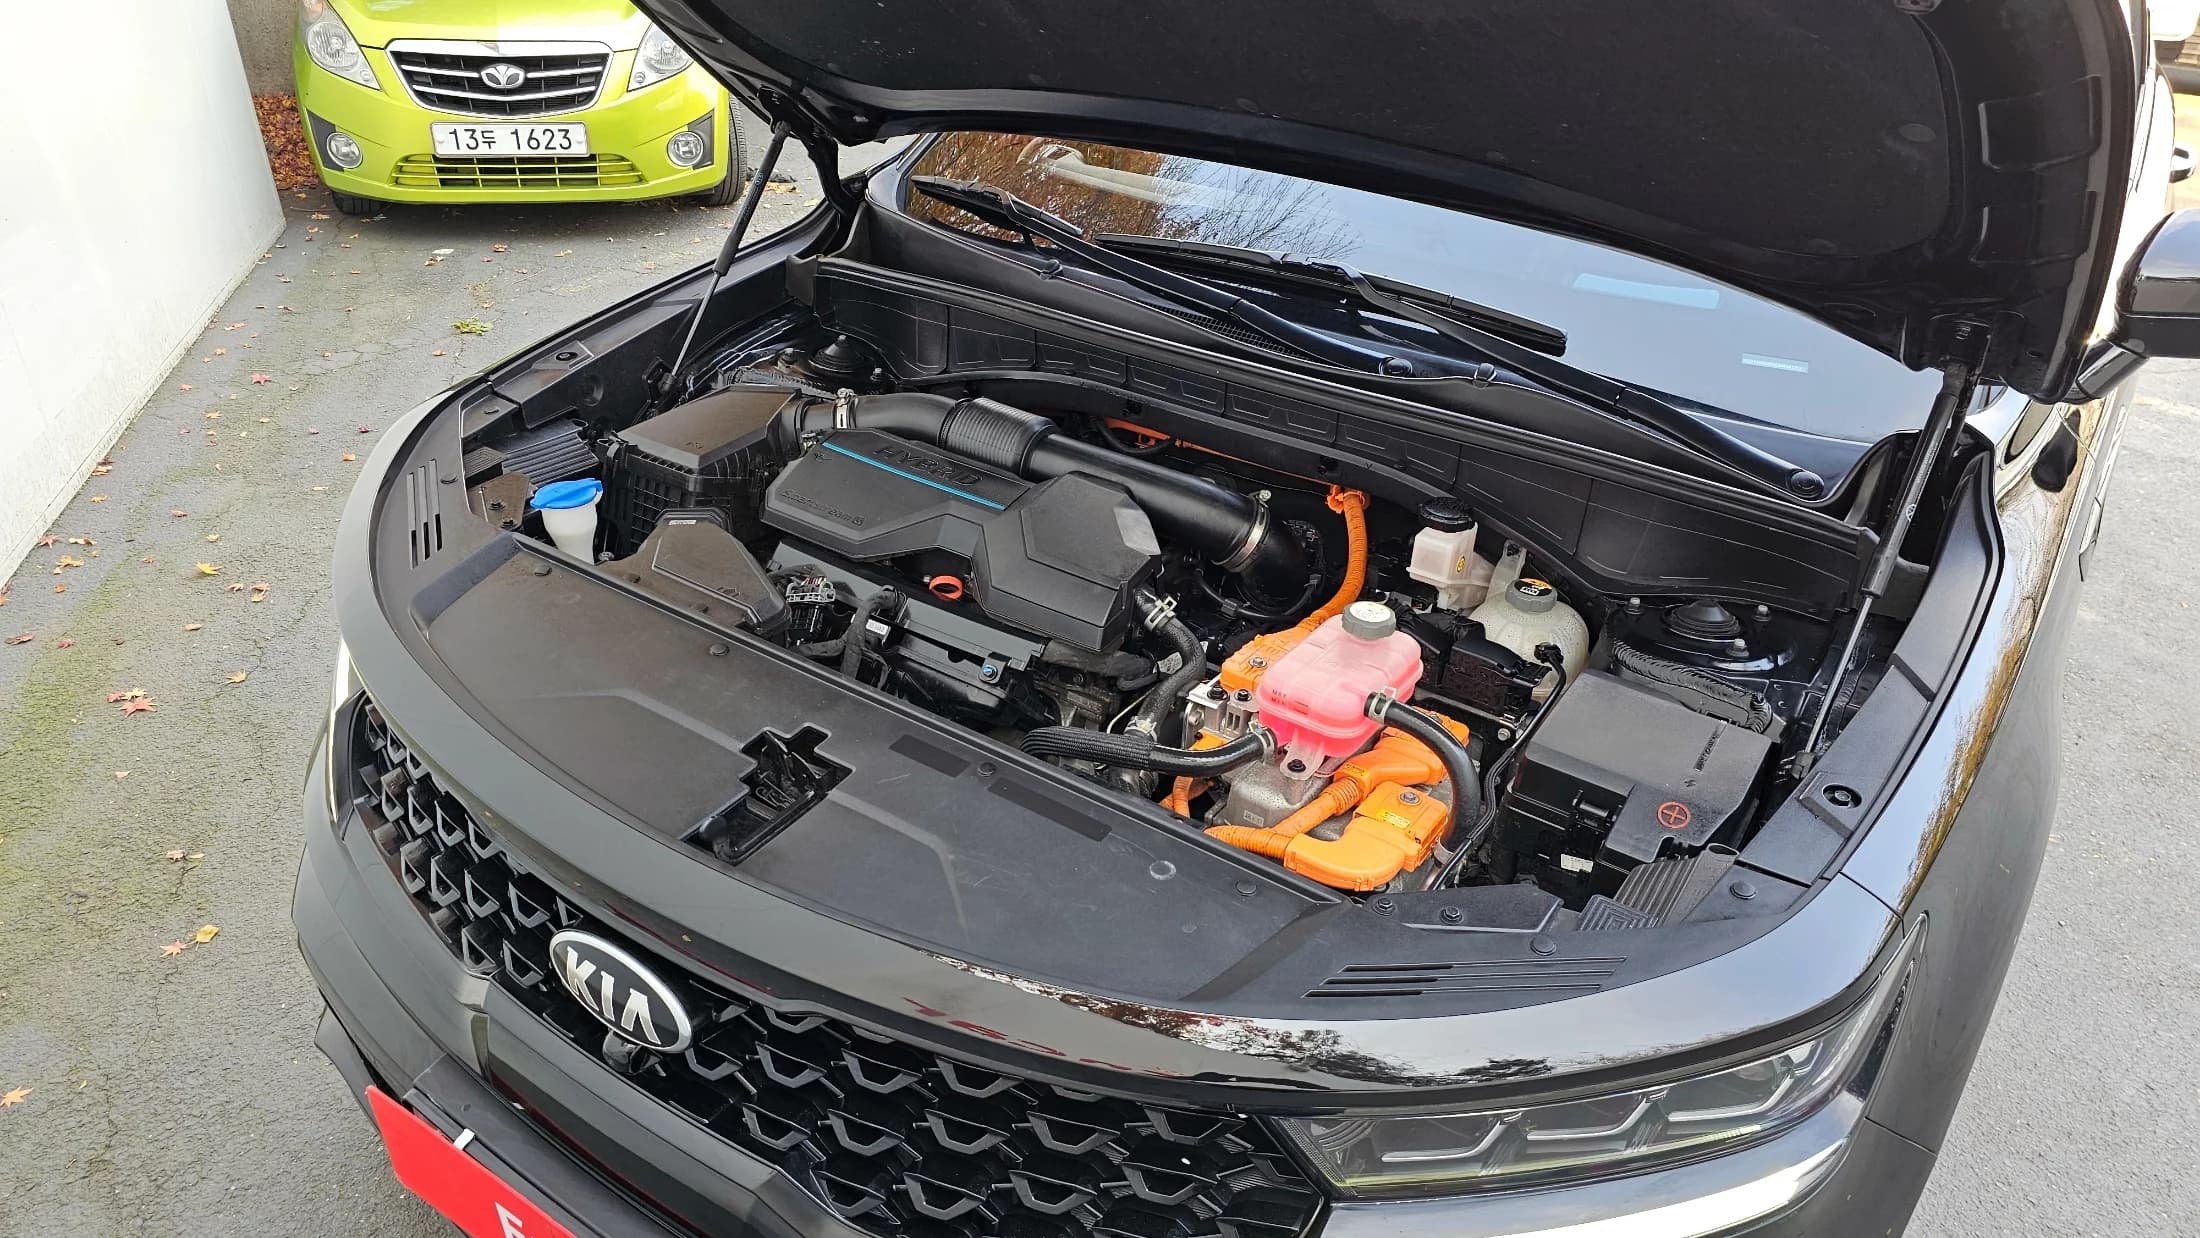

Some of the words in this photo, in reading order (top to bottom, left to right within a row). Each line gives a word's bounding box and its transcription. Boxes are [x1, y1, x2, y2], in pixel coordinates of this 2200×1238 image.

[449, 128, 496, 150] 13두
[510, 128, 572, 150] 1623
[566, 945, 662, 1045] KIA
